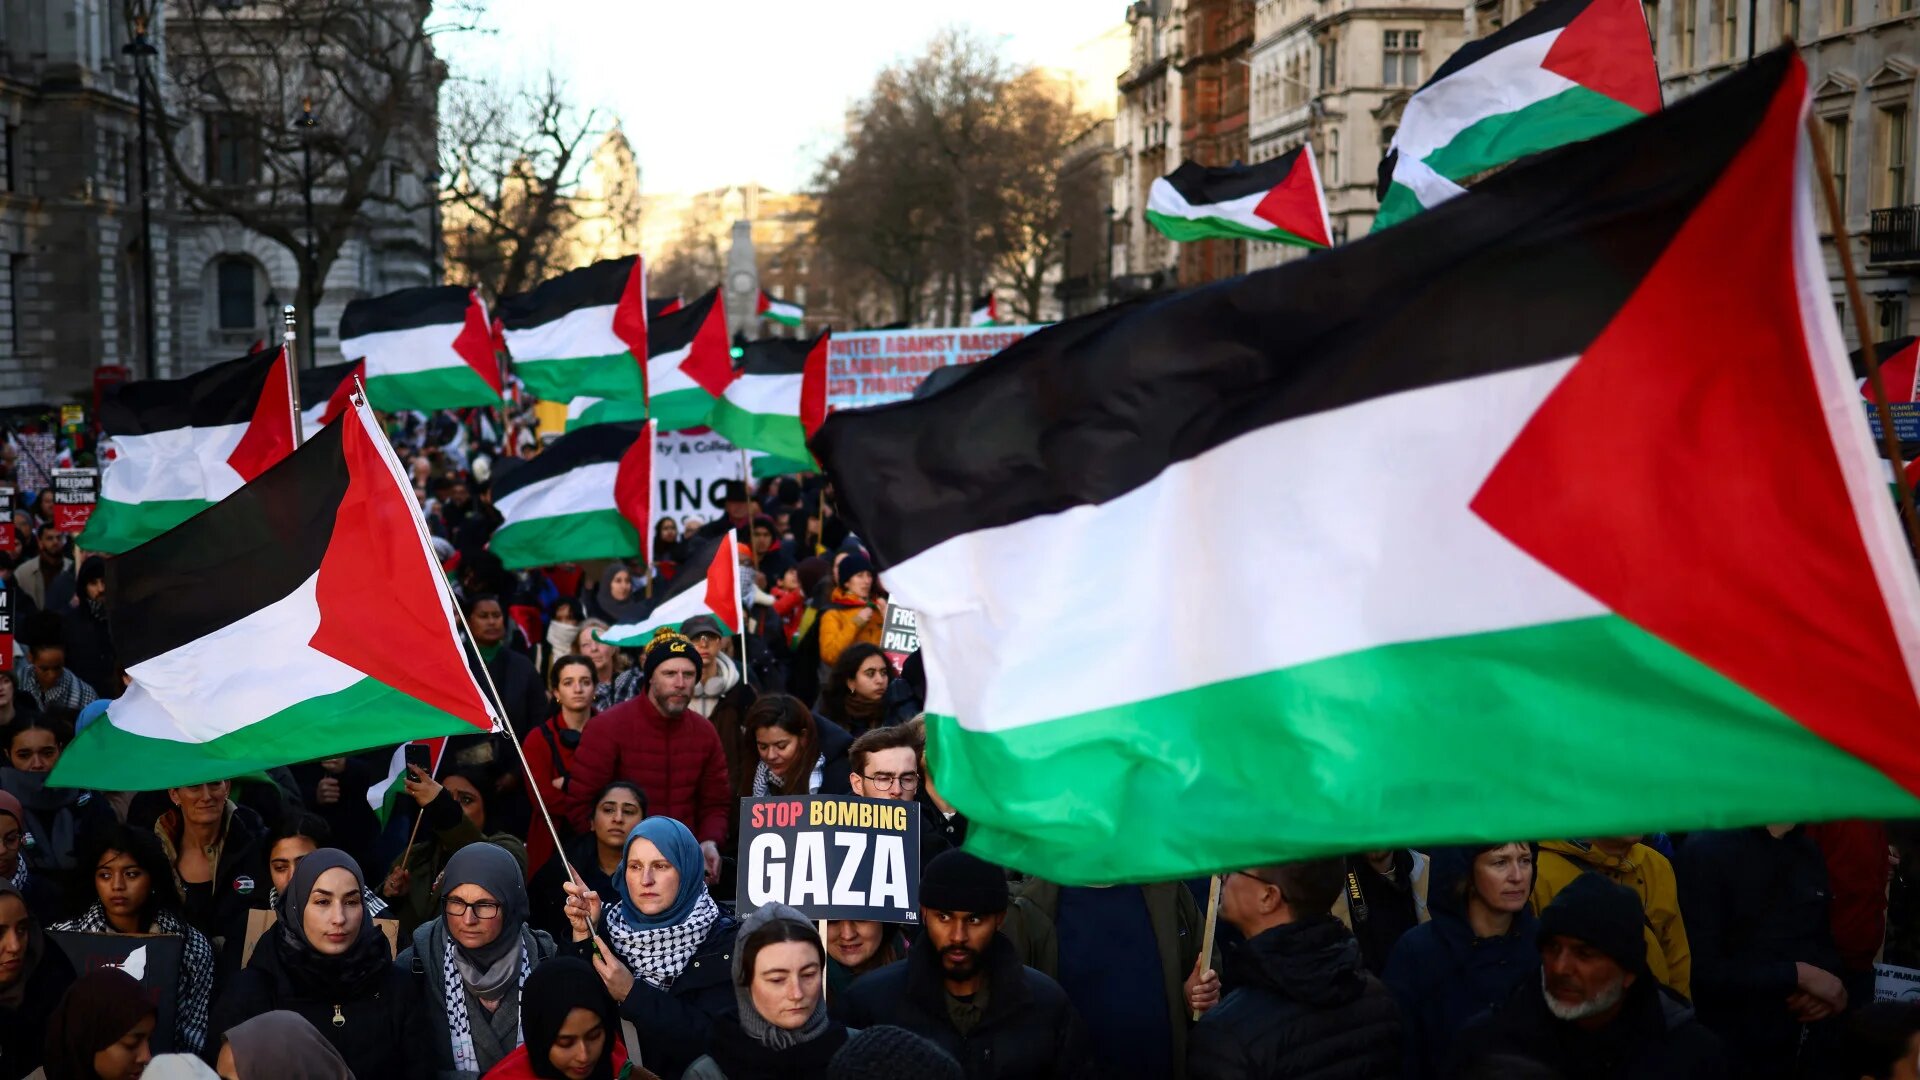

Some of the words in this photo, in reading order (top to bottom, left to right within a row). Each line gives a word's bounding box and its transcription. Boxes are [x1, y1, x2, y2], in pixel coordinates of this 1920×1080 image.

[885, 334, 954, 353] AGAINST
[892, 607, 916, 627] FRE
[670, 641, 687, 652] Cal
[884, 631, 920, 652] PALES
[751, 801, 804, 829] STOP
[809, 800, 908, 831] BOMBING
[748, 831, 910, 909] GAZA
[1348, 872, 1361, 899] Nikon
[905, 911, 918, 921] FOA
